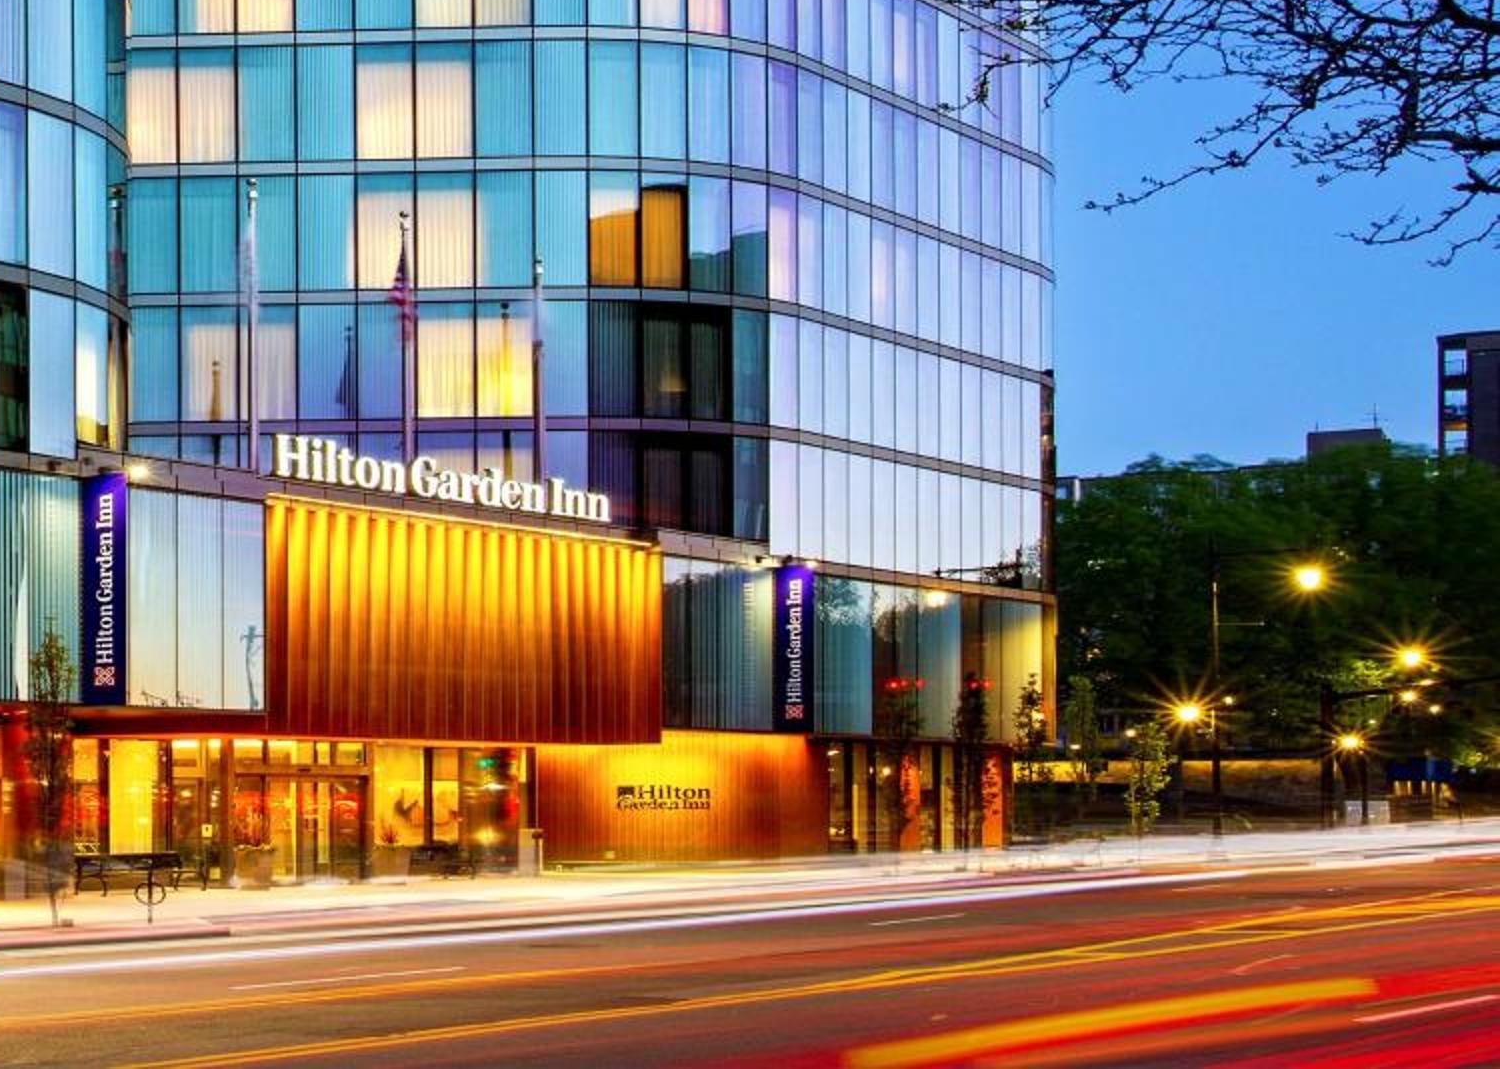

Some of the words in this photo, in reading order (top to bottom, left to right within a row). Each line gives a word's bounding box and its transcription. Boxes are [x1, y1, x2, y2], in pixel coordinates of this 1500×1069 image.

[275, 434, 405, 493] Hilton
[411, 456, 546, 514] Garden
[551, 477, 611, 522] Inn
[96, 493, 113, 529] Inn
[96, 532, 113, 603] Garden
[786, 579, 803, 605] Inn
[96, 605, 113, 664] Hilton
[786, 607, 802, 658] Garden
[786, 660, 802, 702] Hilton
[617, 798, 680, 810] Garden
[682, 799, 711, 810] Inn
[638, 785, 711, 799] Hilton
